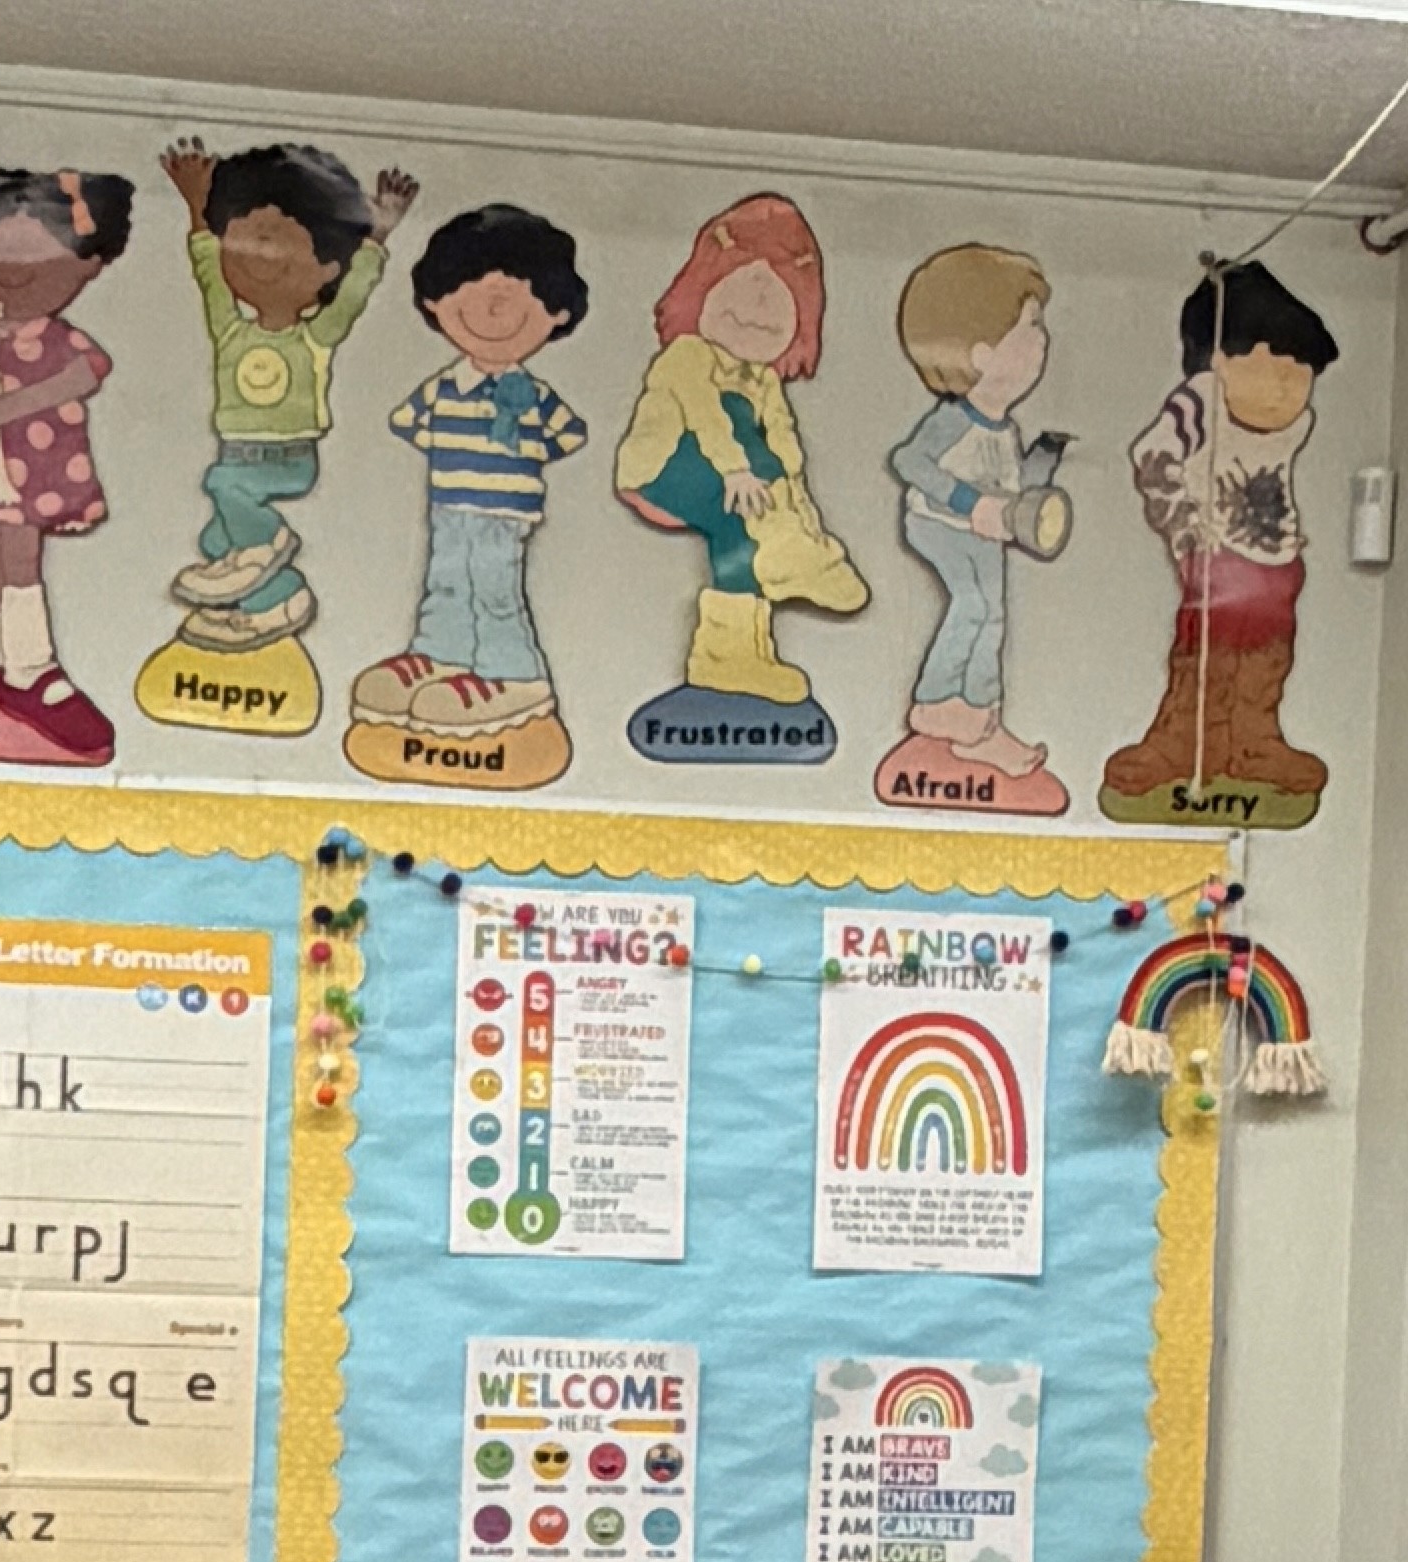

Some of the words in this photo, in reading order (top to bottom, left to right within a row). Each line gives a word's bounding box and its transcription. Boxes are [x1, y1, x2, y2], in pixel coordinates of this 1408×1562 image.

[173, 673, 287, 718] Happy
[645, 716, 826, 748] Frustrated
[403, 738, 506, 774] Proud
[892, 770, 995, 803] Afraid
[1169, 785, 1260, 821] Sorry
[561, 905, 599, 924] ARE
[609, 907, 643, 925] YOU
[93, 942, 251, 974] Formation
[473, 924, 678, 967] FEELING?
[842, 925, 1033, 966] RAINBOW
[866, 963, 1008, 992] BREATHING
[529, 983, 550, 1011] 5
[527, 1026, 547, 1053] 4
[527, 1071, 547, 1100] 3
[525, 1117, 545, 1146] 2
[529, 1163, 539, 1192] 1
[521, 1204, 545, 1233] 0
[495, 1348, 527, 1366] ALL
[532, 1350, 628, 1369] FEELINGS
[633, 1351, 669, 1371] ARE
[186, 1371, 217, 1401] e
[478, 1371, 685, 1412] WELCOME
[556, 1414, 606, 1433] HERE
[842, 1437, 875, 1455] AM
[841, 1464, 874, 1482] AM
[840, 1490, 873, 1508] AM
[838, 1516, 873, 1535] AM
[837, 1543, 872, 1562] AM
